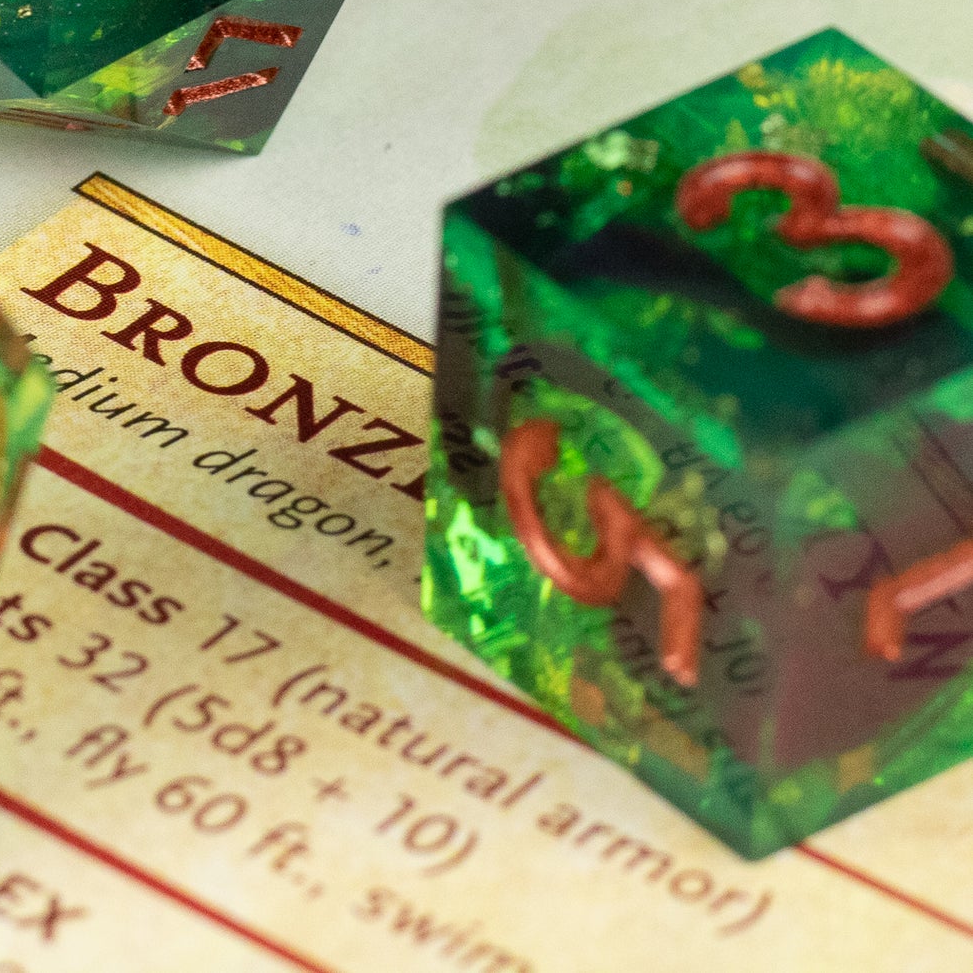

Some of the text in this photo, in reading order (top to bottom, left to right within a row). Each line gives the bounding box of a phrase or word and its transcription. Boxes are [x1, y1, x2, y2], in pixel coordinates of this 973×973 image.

[676, 151, 955, 327] 3
[20, 240, 431, 503] BRONZ
[27, 334, 398, 570] dium dragon,
[20, 523, 775, 940] Class 17 (natural armor)
[56, 630, 151, 695] 32
[141, 682, 309, 778] (5d8
[373, 792, 480, 878] 10)
[63, 722, 151, 793] fly
[152, 773, 249, 835] 60
